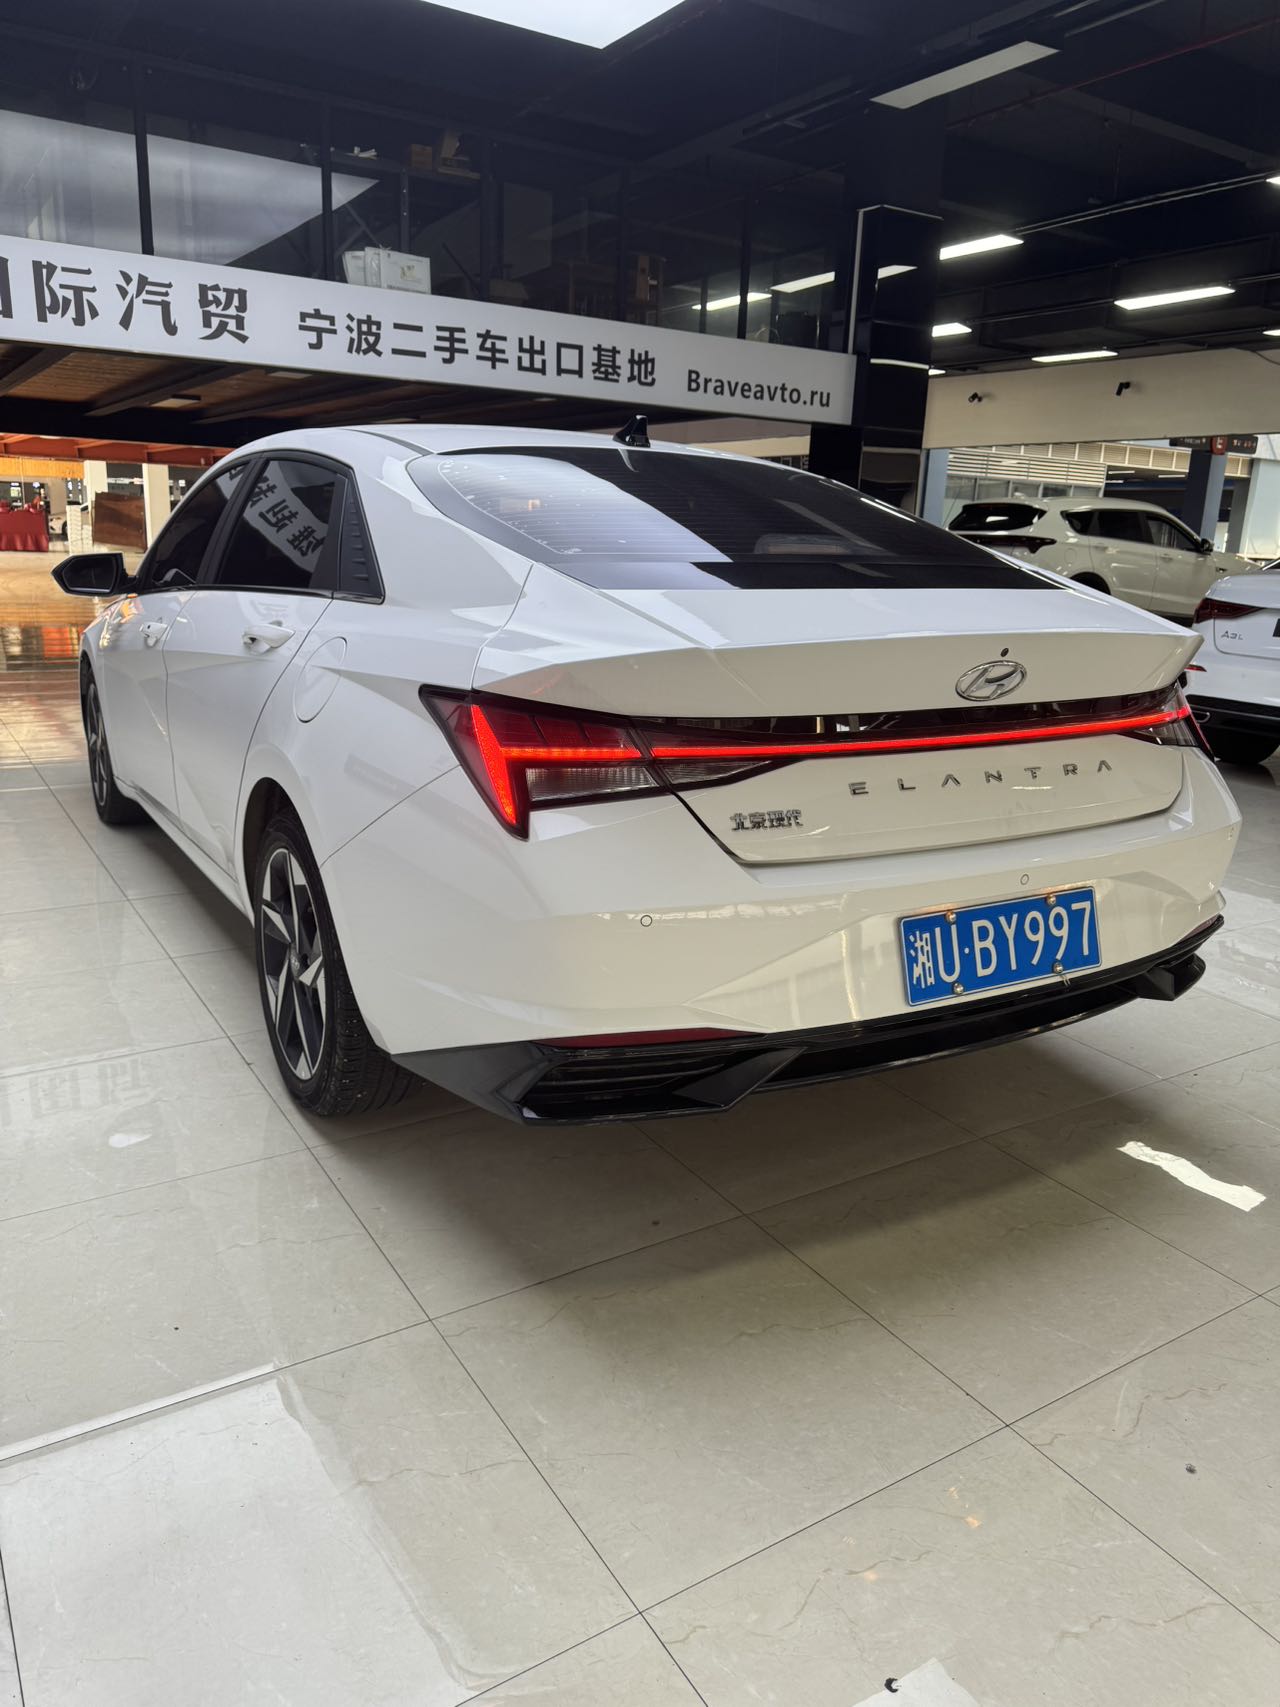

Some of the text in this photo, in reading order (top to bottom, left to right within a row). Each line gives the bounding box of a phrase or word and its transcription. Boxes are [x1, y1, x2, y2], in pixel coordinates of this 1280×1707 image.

[0, 255, 831, 407] 际汽贸 宁波二手车出口基地 Braveavto.ru
[1221, 630, 1243, 640] A3L
[848, 759, 1112, 795] ELANTRA
[730, 809, 803, 831] 北京现代
